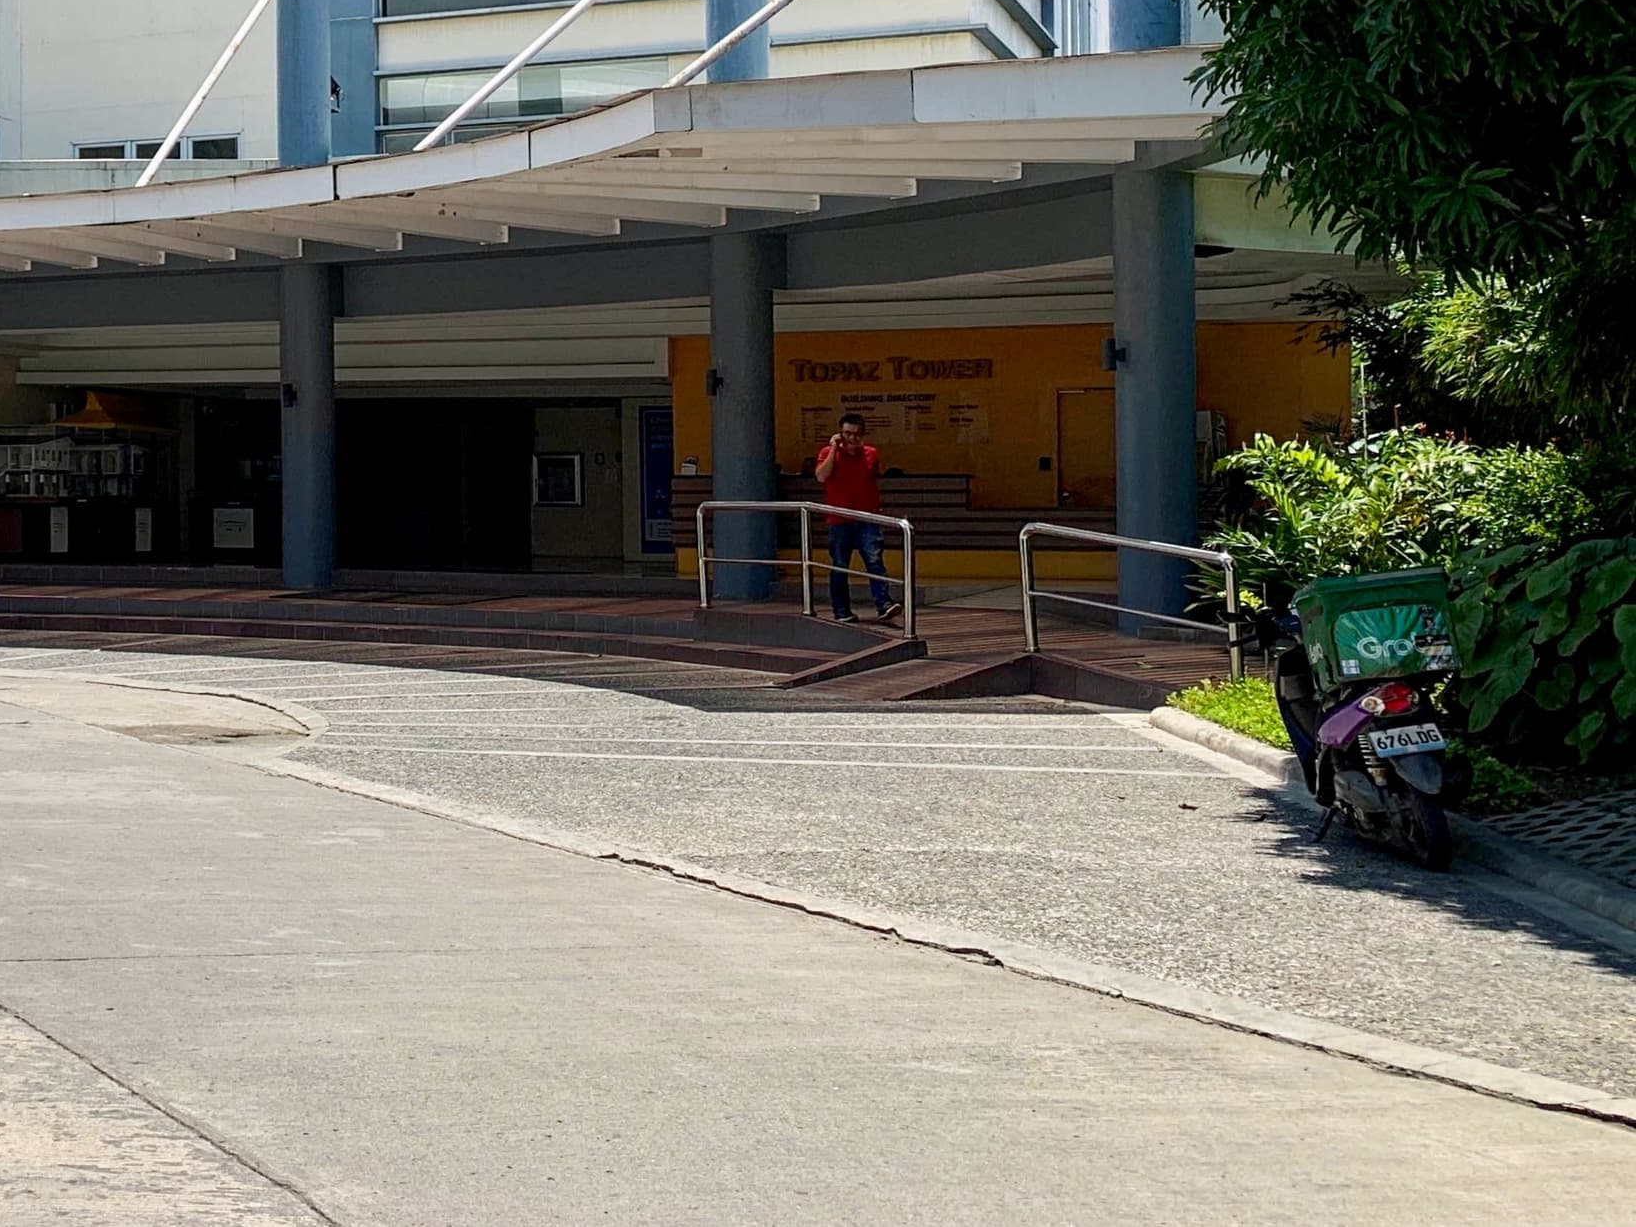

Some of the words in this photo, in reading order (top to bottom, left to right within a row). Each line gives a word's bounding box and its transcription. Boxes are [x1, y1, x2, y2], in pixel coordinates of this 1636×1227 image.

[788, 358, 883, 382] TOPAZ
[884, 356, 994, 380] TOWER
[1376, 729, 1441, 750] 676LDG
